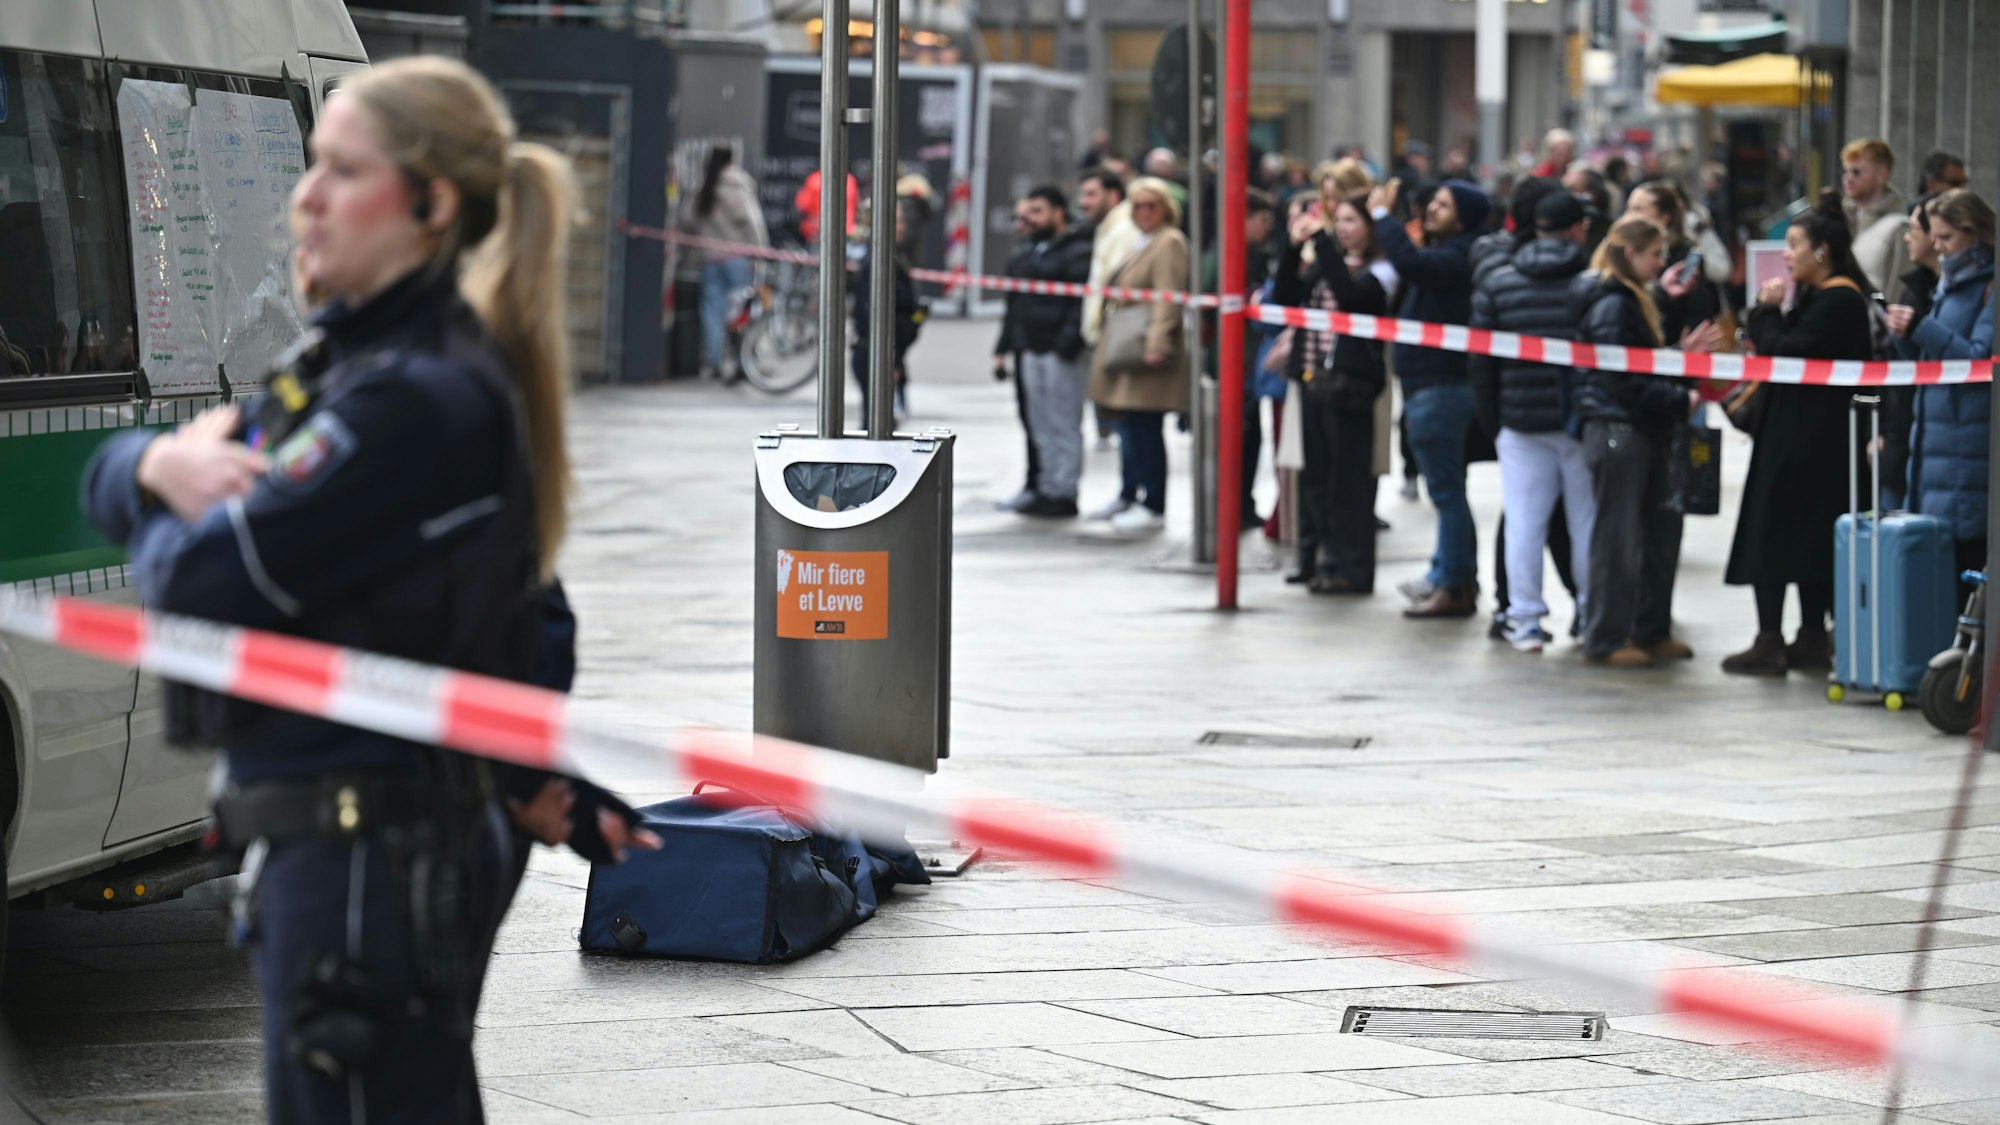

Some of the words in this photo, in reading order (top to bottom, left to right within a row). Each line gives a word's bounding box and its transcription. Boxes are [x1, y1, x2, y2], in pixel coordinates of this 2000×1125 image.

[798, 561, 825, 585] Mir
[828, 562, 865, 585] fiere
[799, 591, 815, 611] et
[818, 588, 863, 612] Levve
